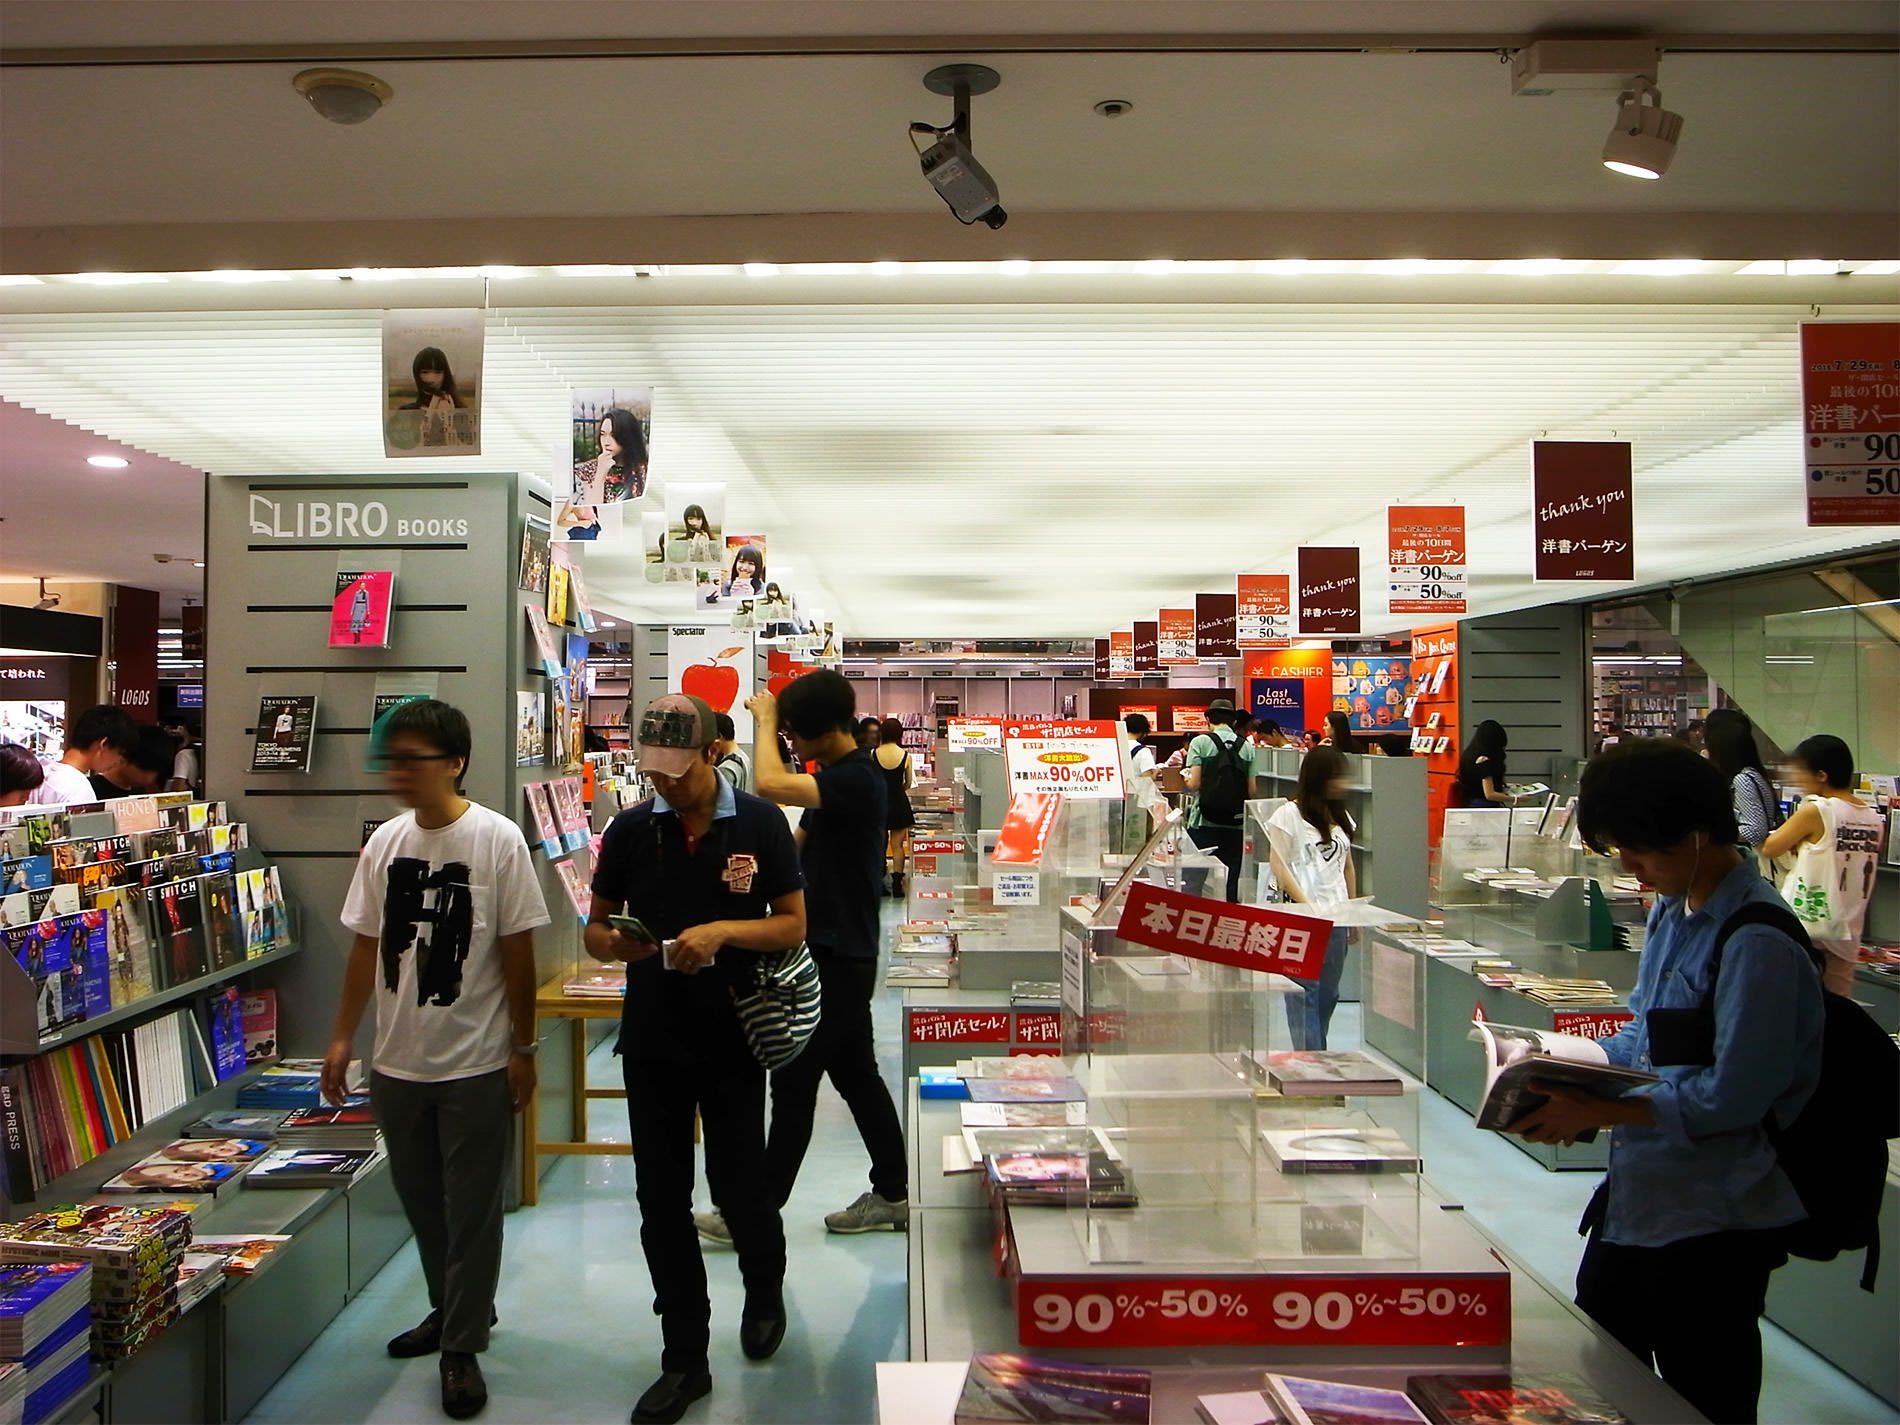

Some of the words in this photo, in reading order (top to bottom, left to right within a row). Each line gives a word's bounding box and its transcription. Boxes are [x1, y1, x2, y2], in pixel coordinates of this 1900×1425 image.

[1540, 495, 1594, 521] thank
[1596, 490, 1625, 515] you
[274, 501, 388, 537] LIBRO
[397, 519, 468, 537] BOOKS
[1542, 539, 1627, 554] 洋書バーゲン
[1390, 549, 1465, 564] 洋書バーゲン
[1301, 580, 1336, 597] thank
[1337, 577, 1356, 592] you
[1302, 607, 1357, 618] 洋書バーゲン
[672, 627, 706, 636] Spectator
[1271, 666, 1324, 679] CASHIER
[121, 689, 150, 706] LOGOS
[1266, 687, 1288, 698] Last
[1050, 765, 1114, 782] 90%OFF
[160, 880, 197, 900] SWITCH
[1141, 902, 1310, 963] 本日最終日
[6, 1111, 21, 1150] PRESS
